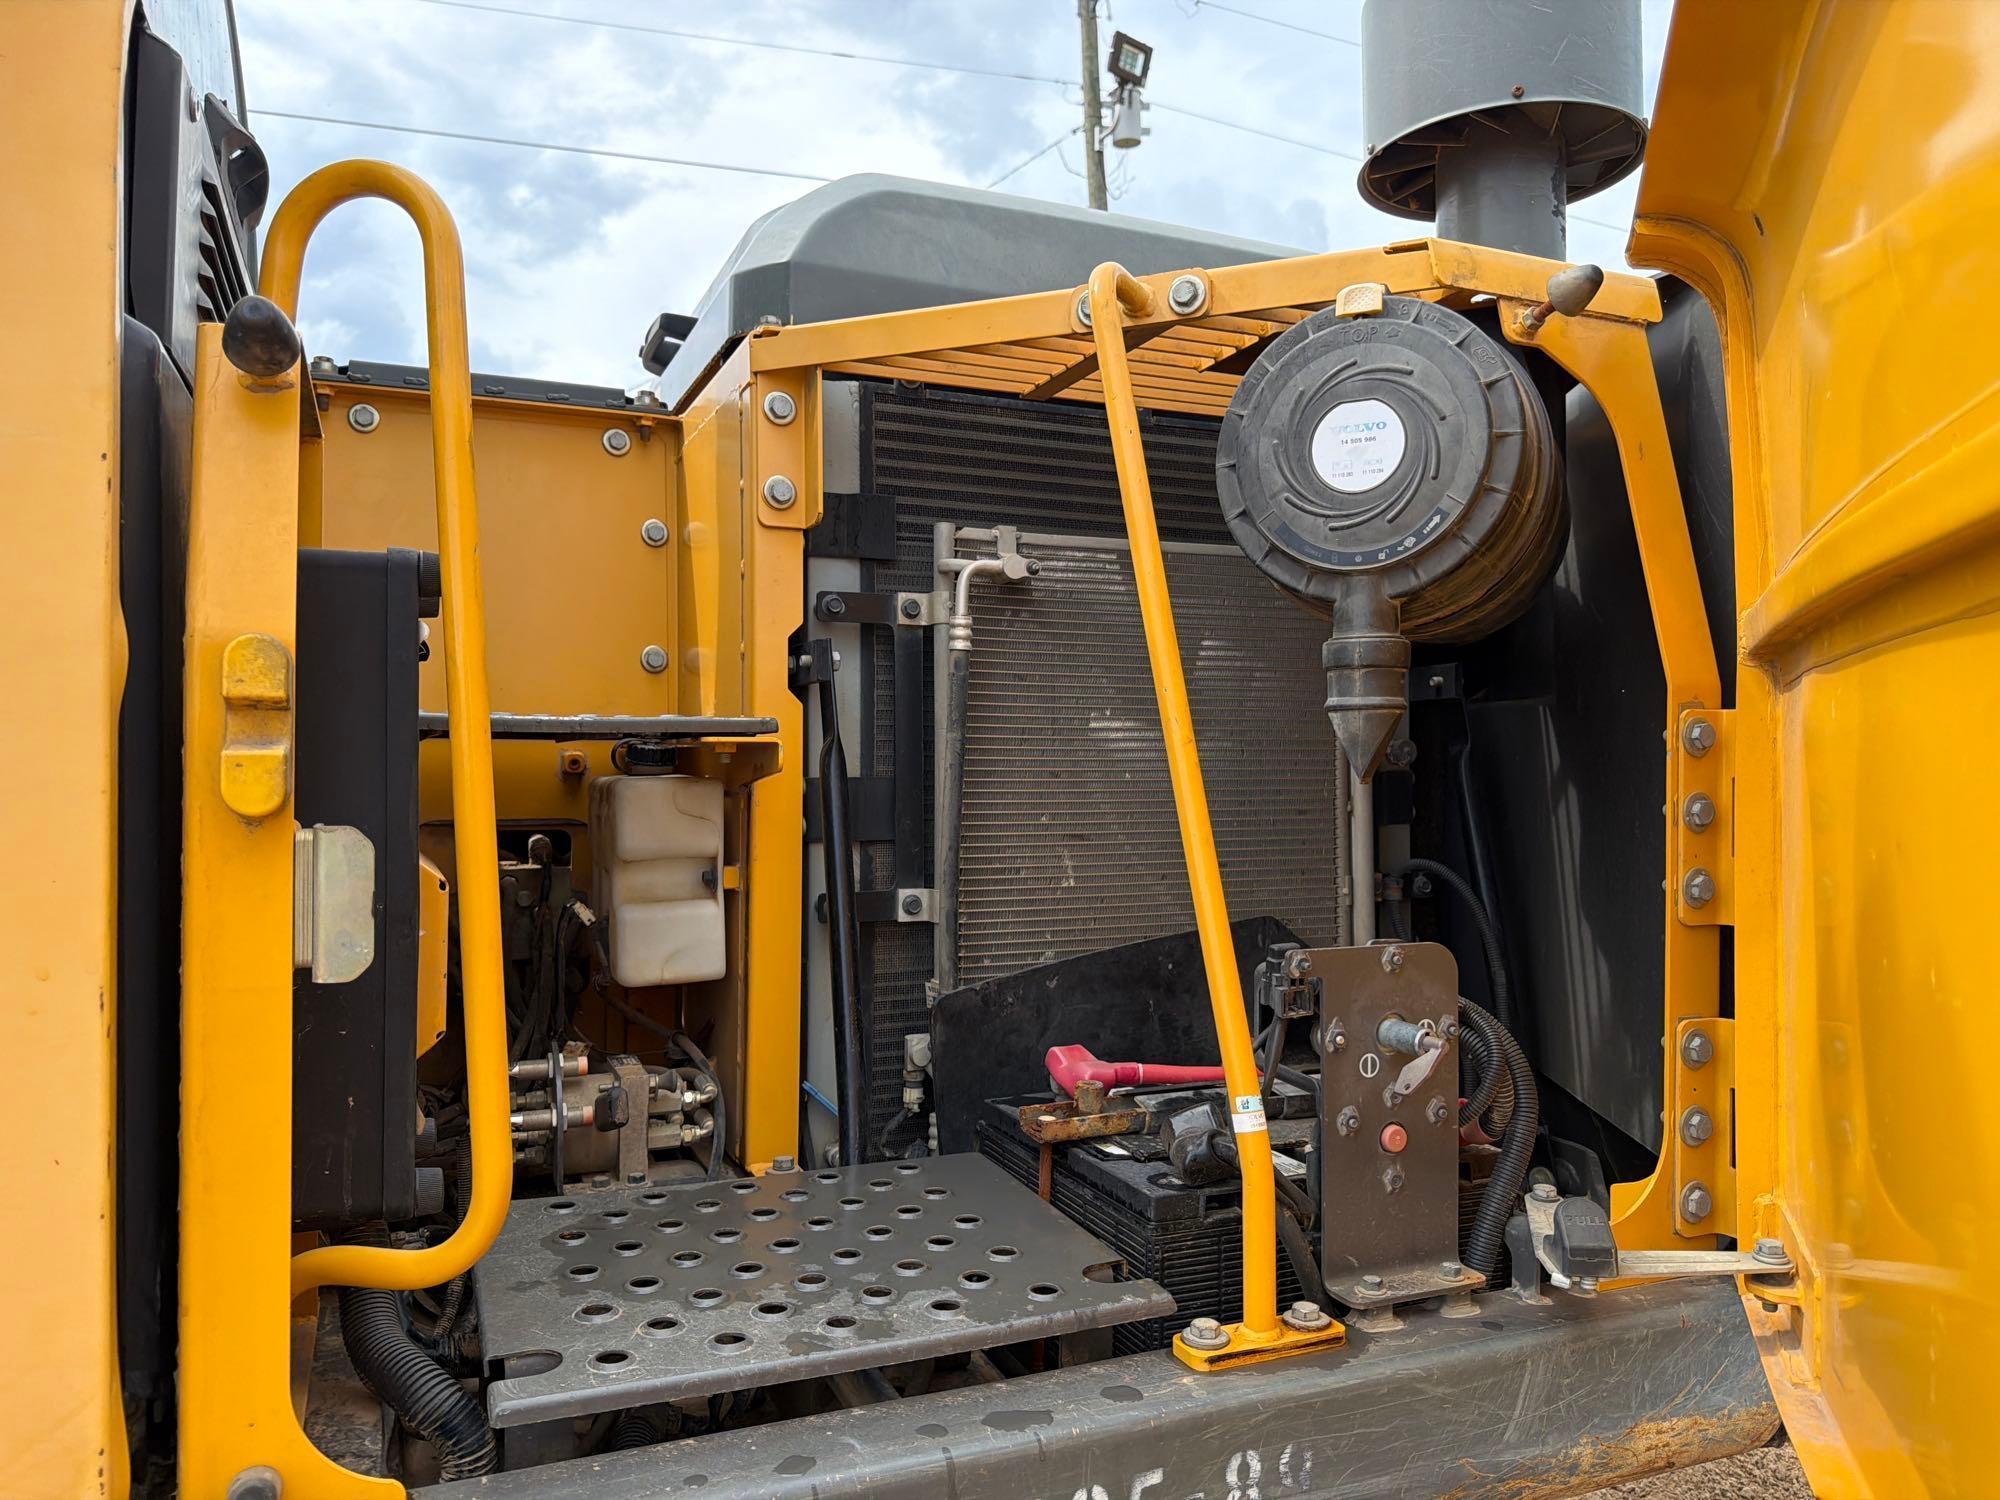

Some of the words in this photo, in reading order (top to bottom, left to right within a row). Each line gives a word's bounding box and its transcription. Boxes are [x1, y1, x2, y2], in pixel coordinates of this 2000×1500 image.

[1340, 326, 1379, 343] TOP
[1328, 421, 1387, 433] VOLVO
[1567, 1215, 1605, 1225] PULL
